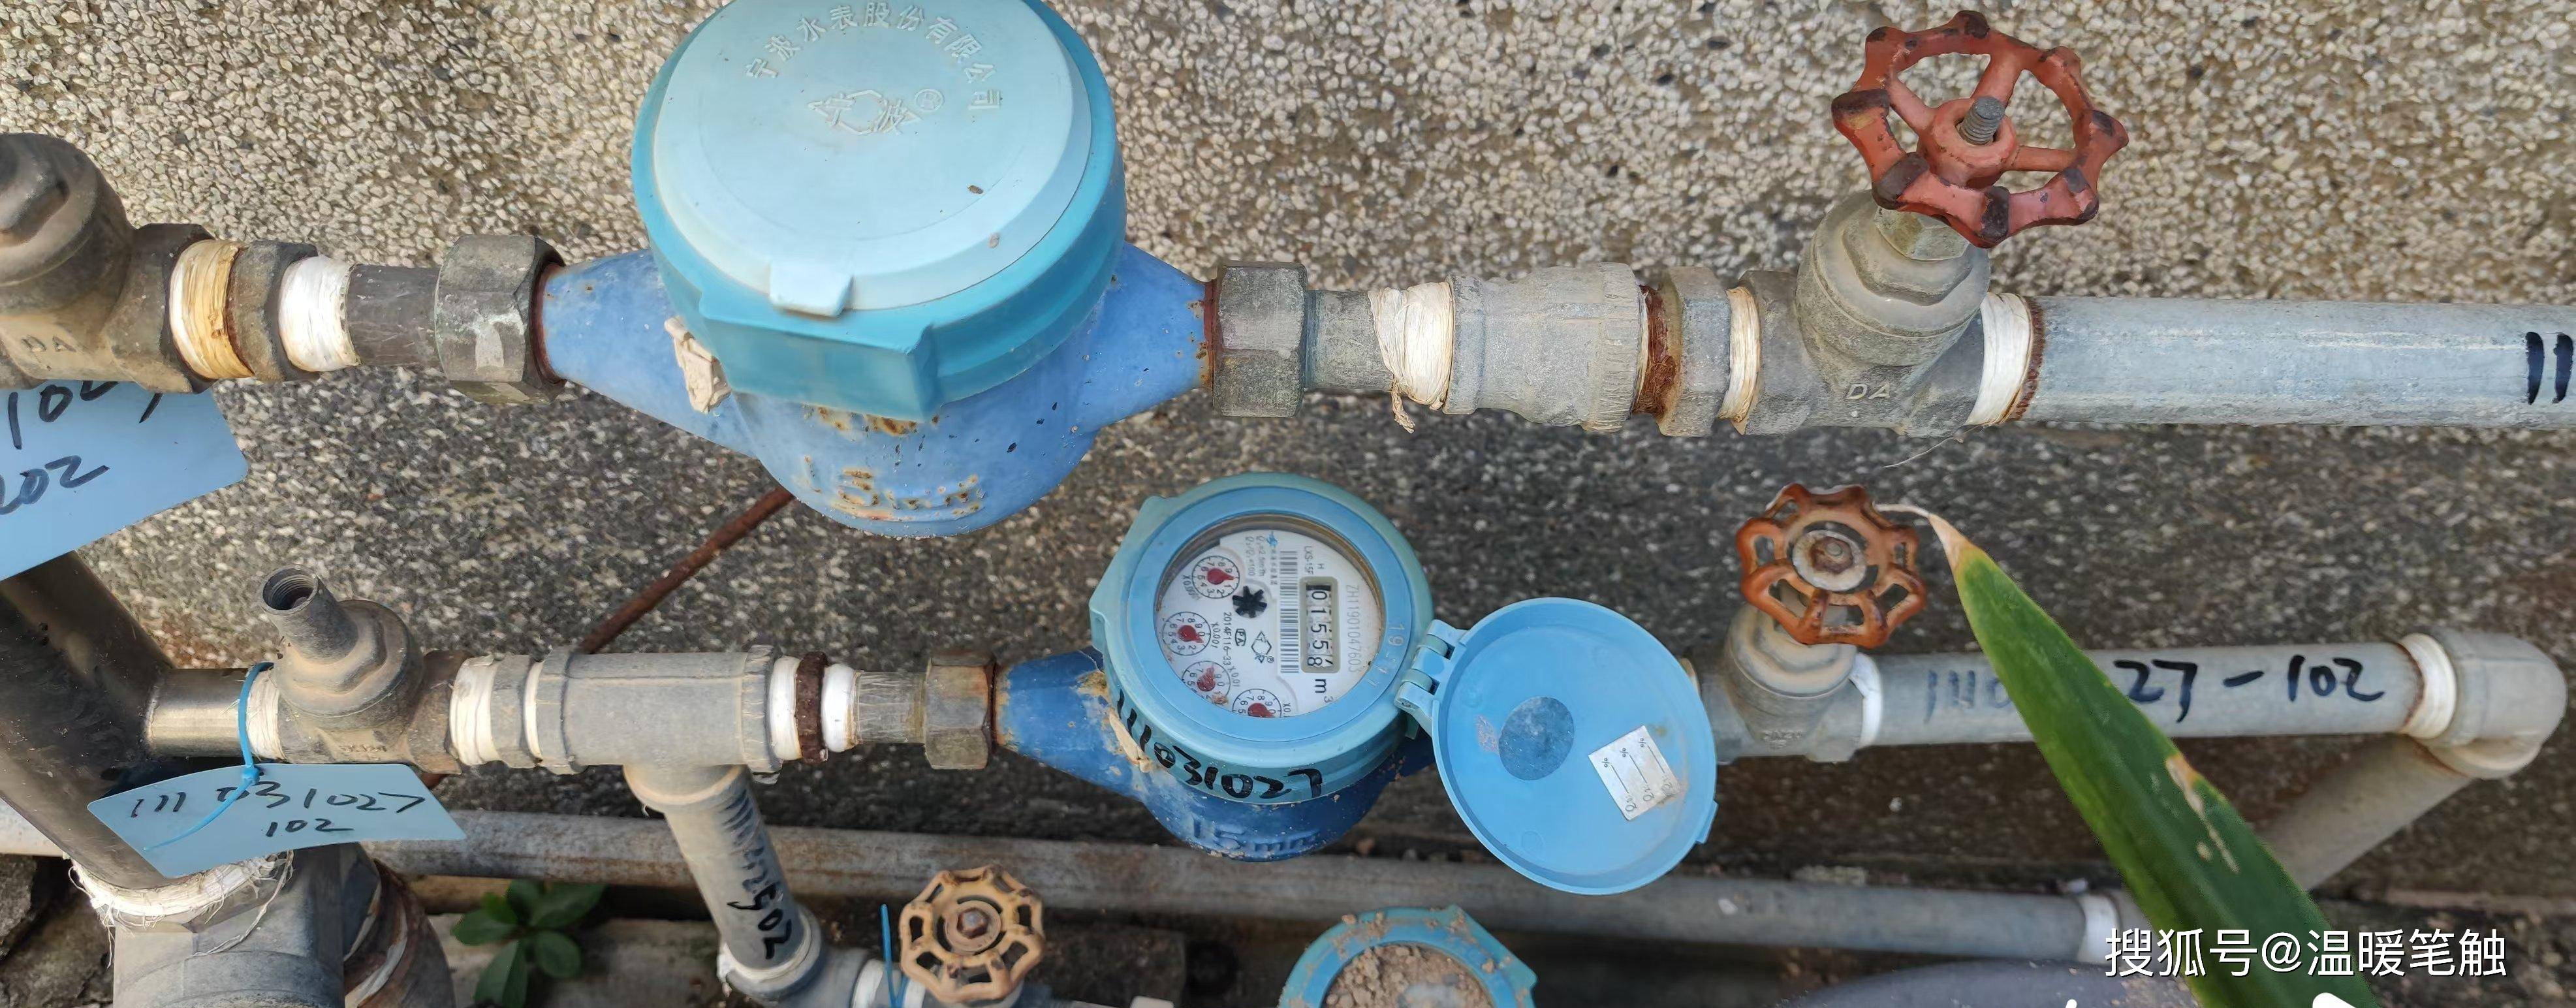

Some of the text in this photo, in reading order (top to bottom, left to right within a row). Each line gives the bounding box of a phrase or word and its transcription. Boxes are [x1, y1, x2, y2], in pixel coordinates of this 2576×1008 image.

[745, 1, 1003, 110] 宁波水表股份有限公司
[1845, 381, 1894, 402] DA
[266, 818, 354, 838] 102
